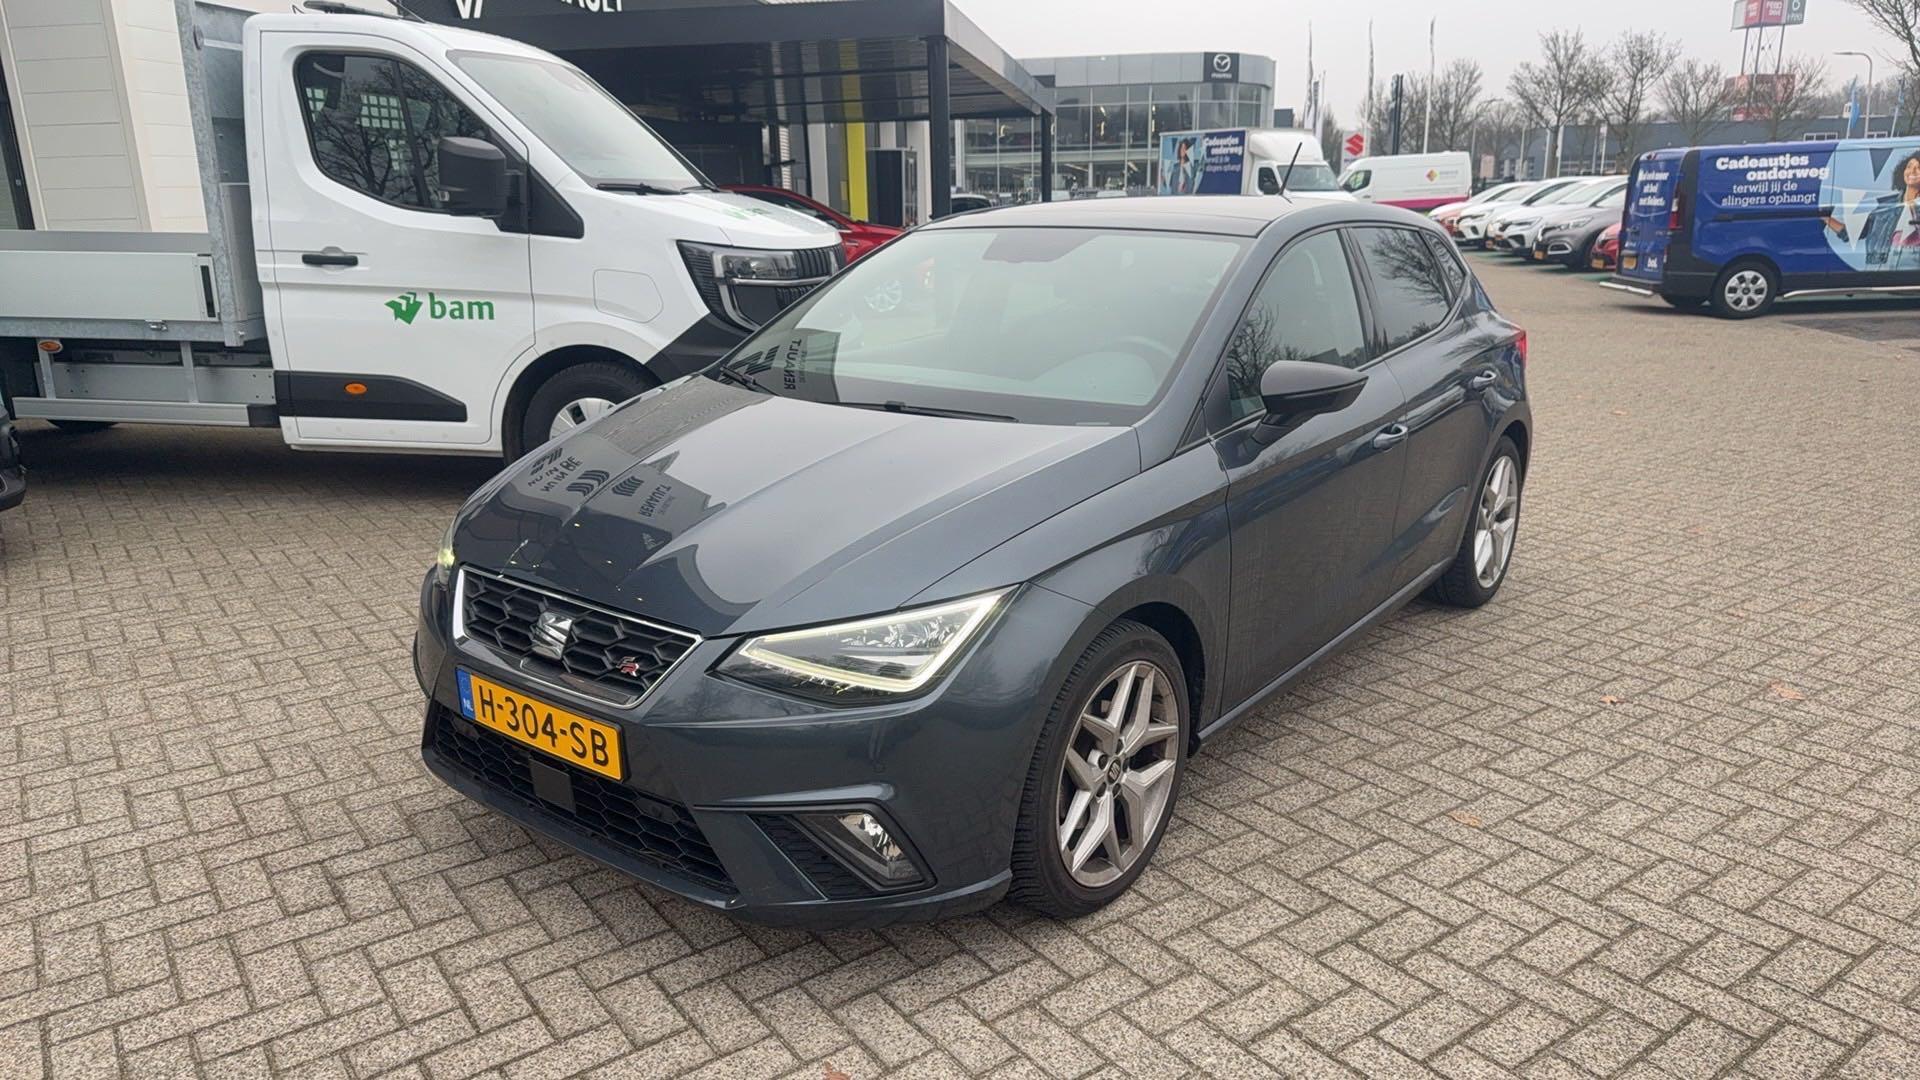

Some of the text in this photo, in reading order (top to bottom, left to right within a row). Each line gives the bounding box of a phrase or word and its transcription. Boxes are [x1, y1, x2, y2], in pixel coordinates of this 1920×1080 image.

[1716, 153, 1809, 170] Cadeautjes
[1746, 166, 1830, 181] onderweg
[1733, 181, 1798, 194] terwijl jij de
[1722, 191, 1816, 207] slingers ophangt
[428, 292, 495, 320] bam
[479, 685, 609, 767] H-304-SB
